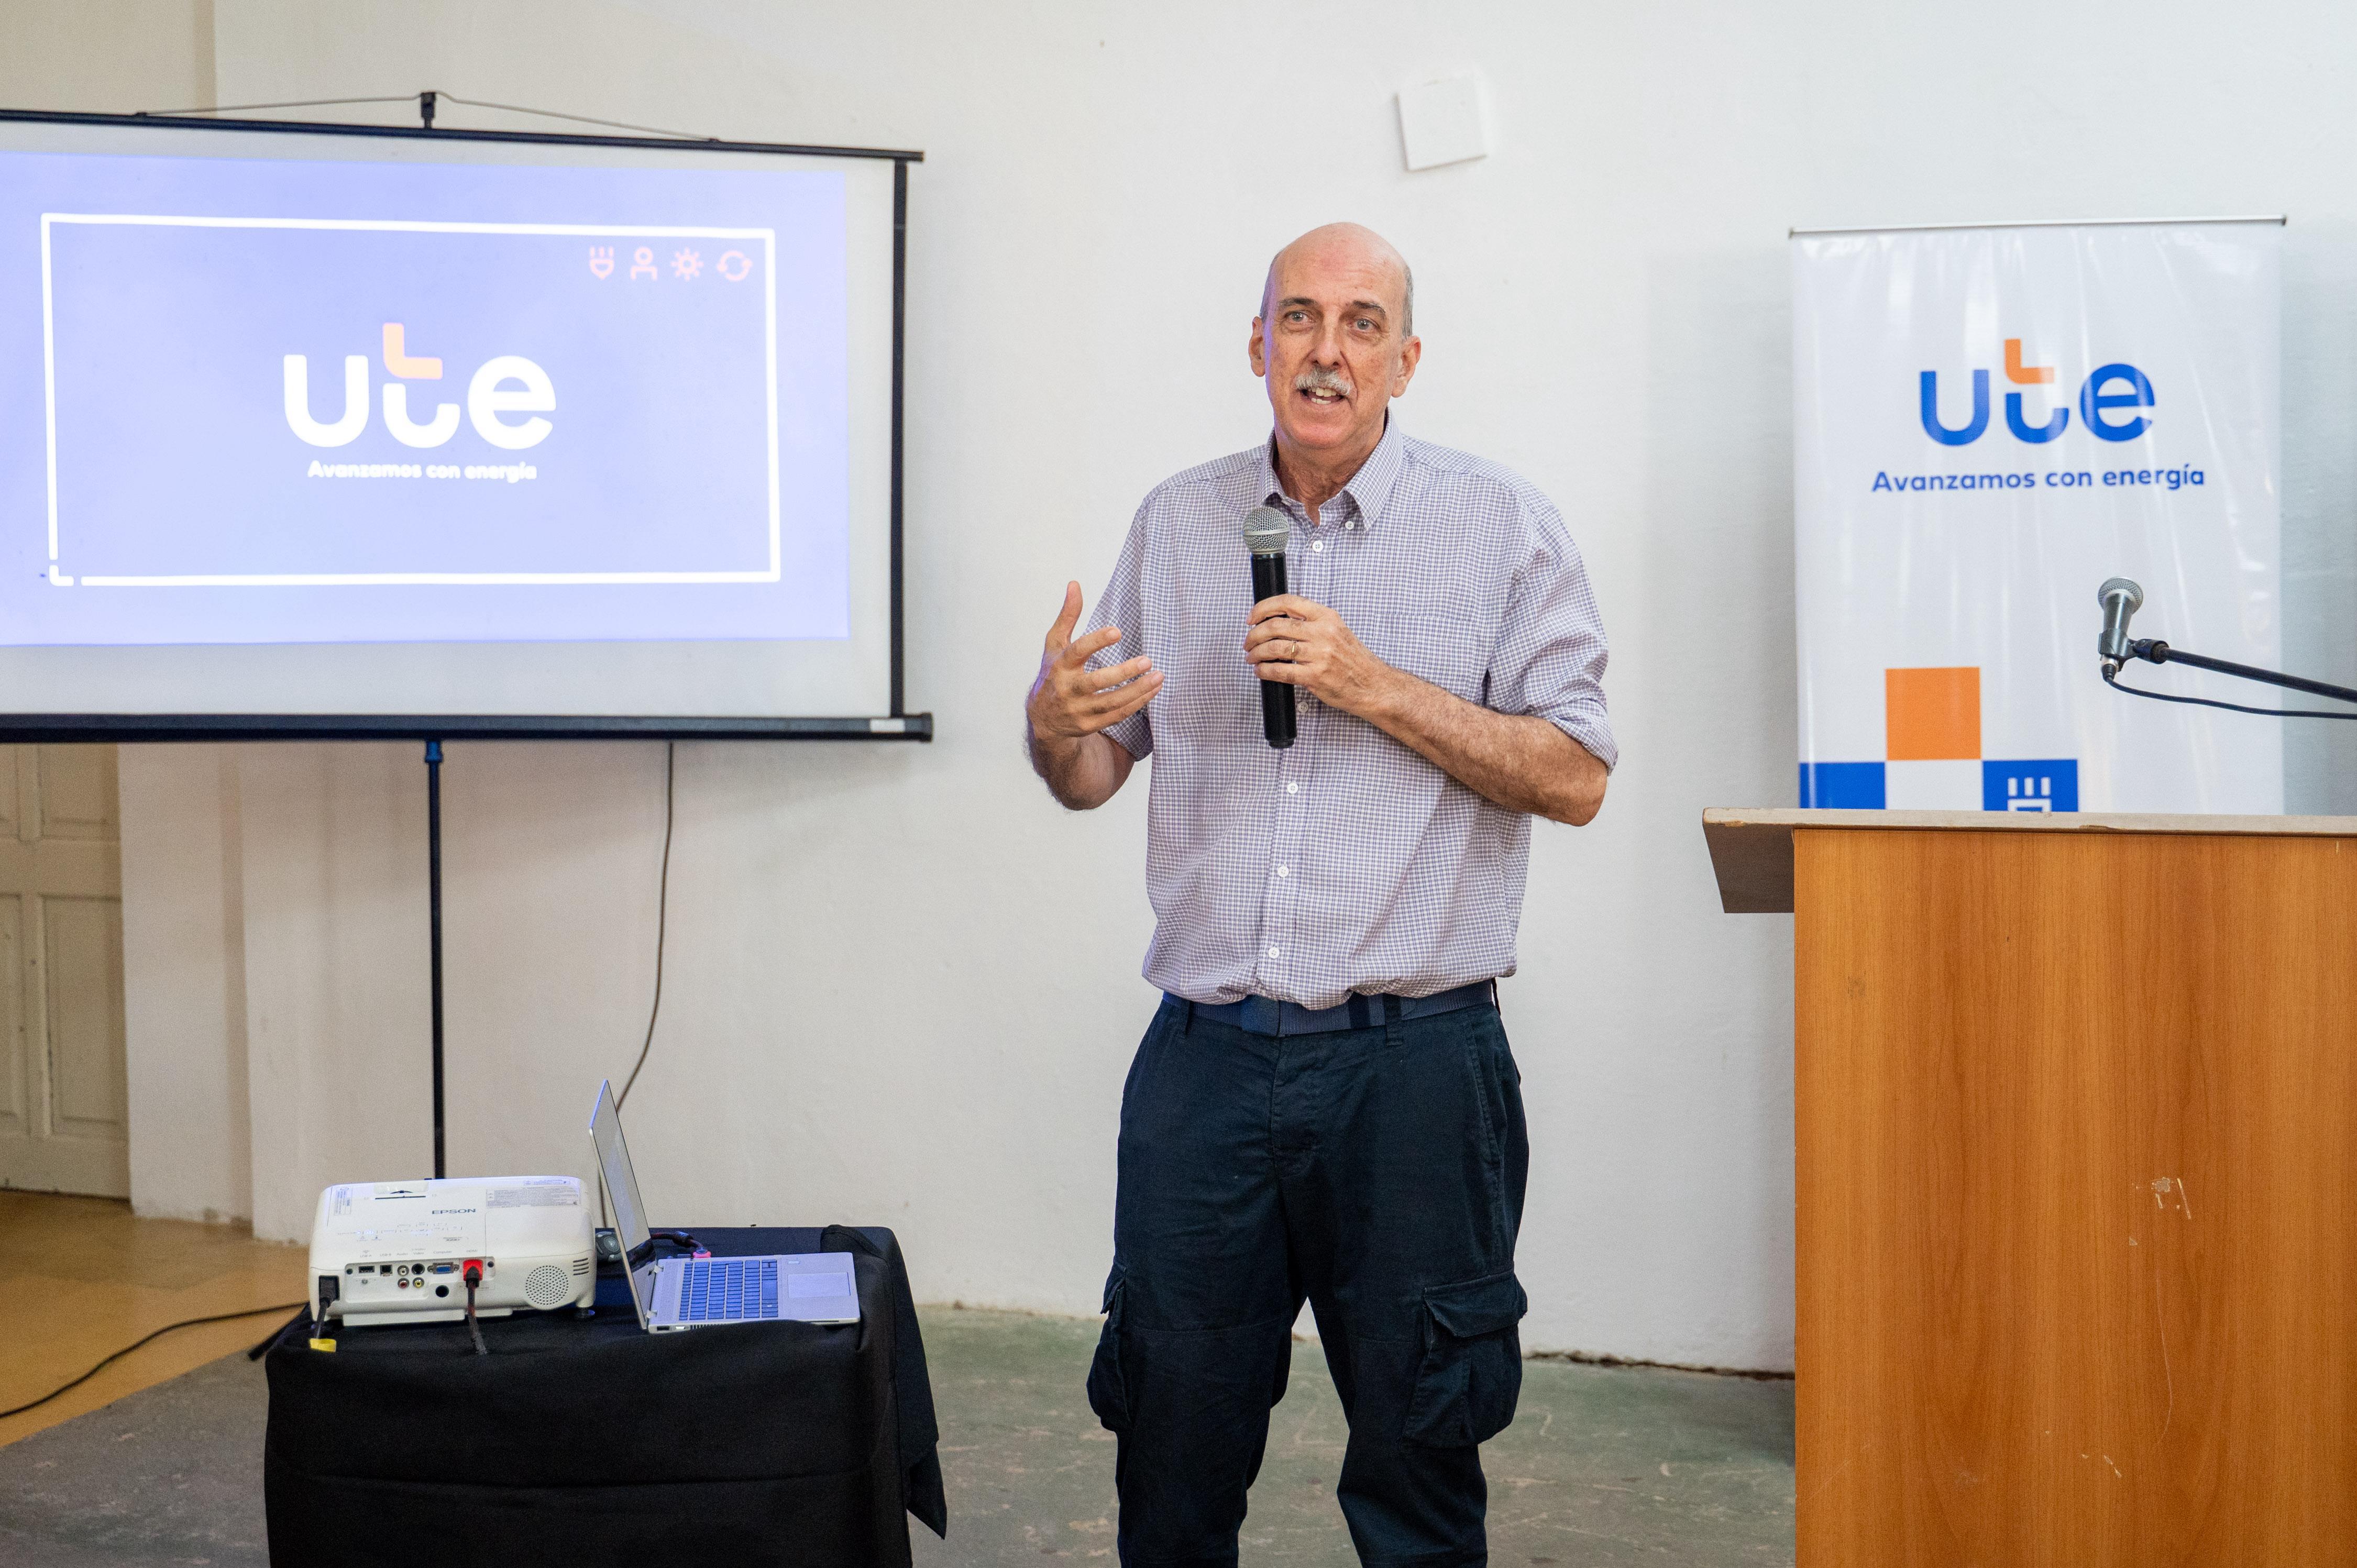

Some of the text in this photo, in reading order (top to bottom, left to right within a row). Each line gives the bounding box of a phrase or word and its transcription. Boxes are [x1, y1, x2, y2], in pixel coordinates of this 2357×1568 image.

[283, 322, 557, 450] ute
[1920, 338, 2155, 447] ute
[307, 460, 537, 484] Avanzamos con energía
[1871, 463, 2206, 492] Avanzamos con energía
